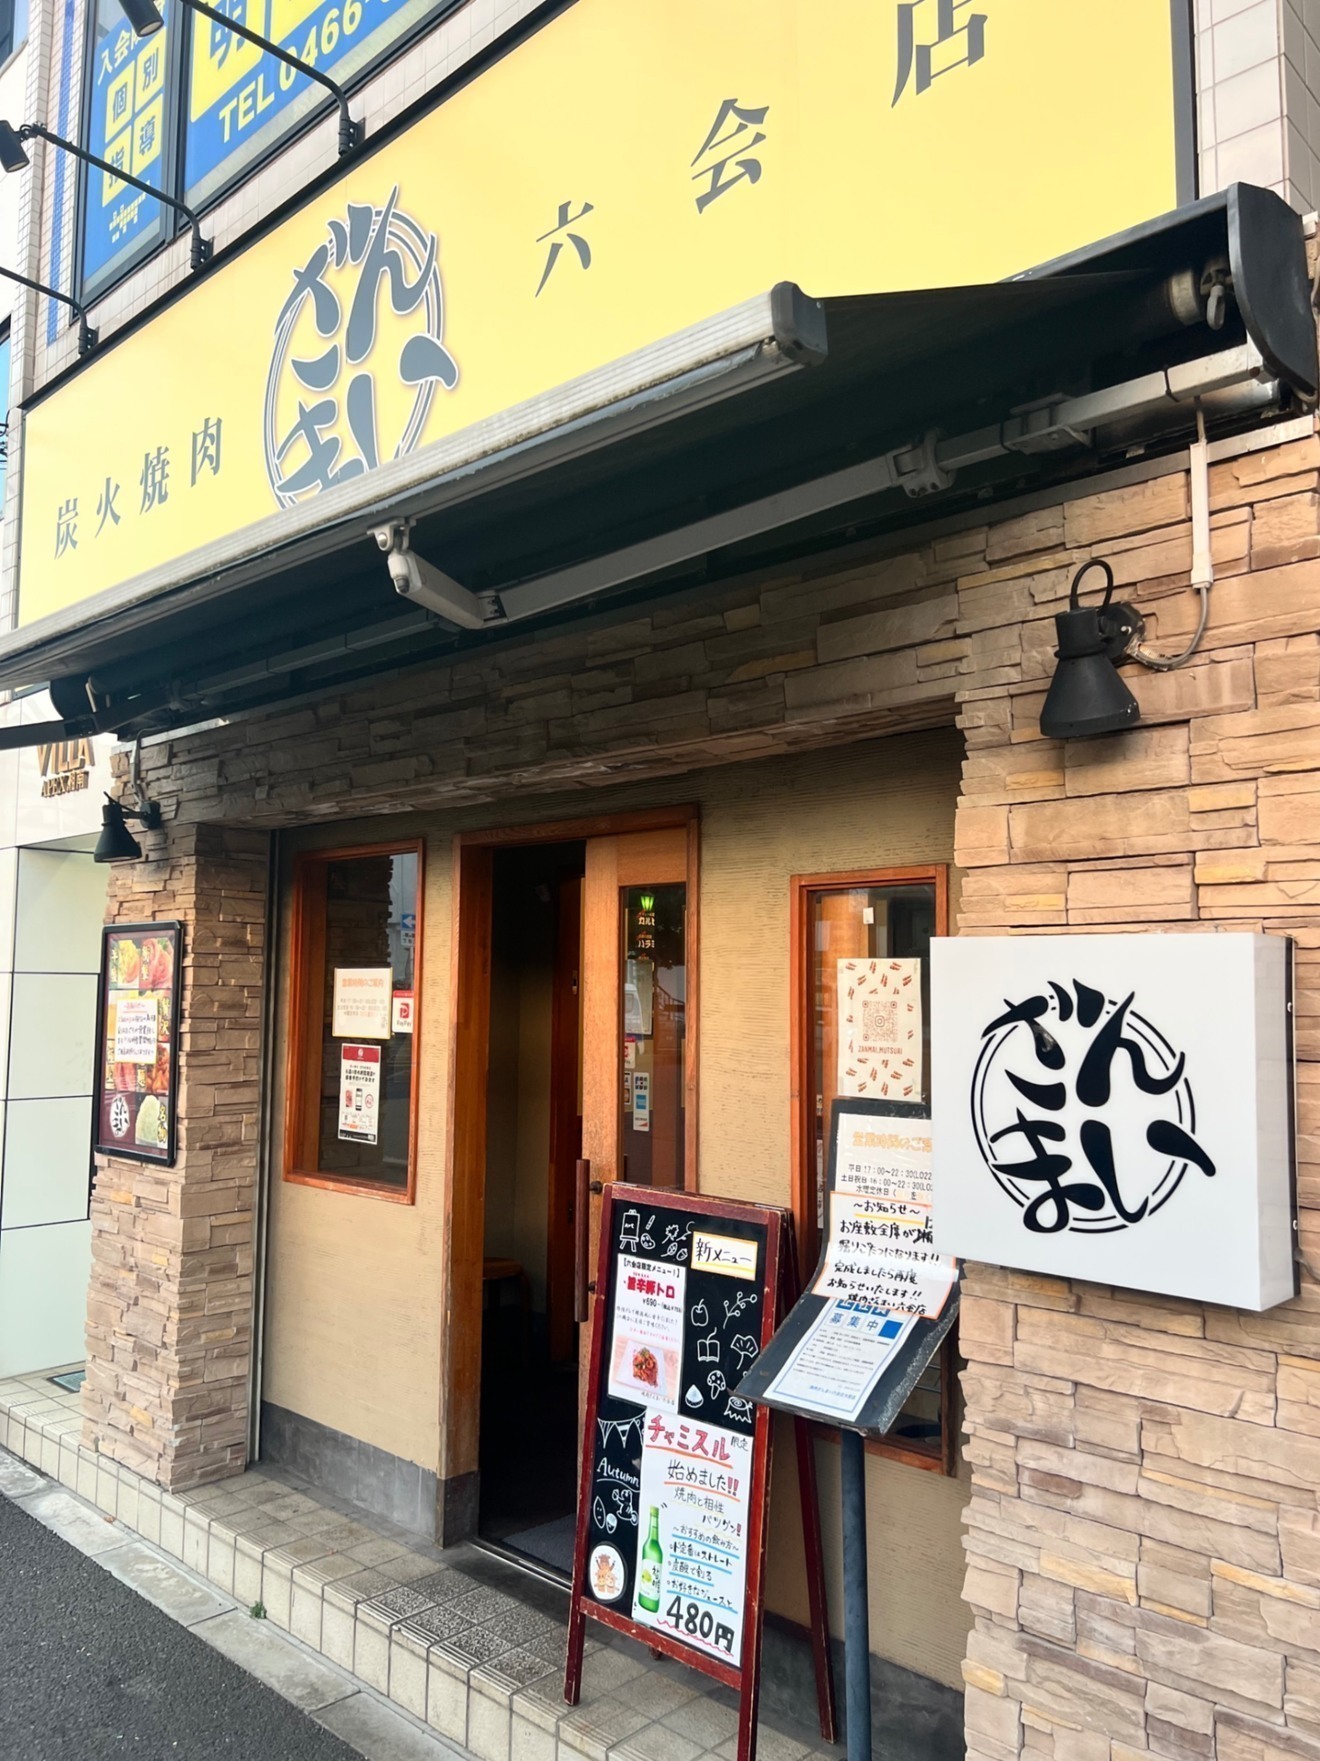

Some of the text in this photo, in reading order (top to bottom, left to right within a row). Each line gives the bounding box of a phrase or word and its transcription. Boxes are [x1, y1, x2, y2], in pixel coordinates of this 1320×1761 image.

[218, 0, 391, 144] TEL 0466
[54, 416, 223, 560] 炭火焼肉
[37, 737, 95, 778] VILLA
[980, 977, 1217, 1234] ざんまい
[841, 1174, 867, 1184] 土日祝日
[848, 1163, 862, 1173] 平日
[695, 1237, 752, 1264] 新メニュー
[829, 1312, 879, 1332] 募集中
[648, 1414, 731, 1461] チャミスル
[596, 1457, 640, 1488] Autumn
[674, 1487, 725, 1515] 焼肉と相性
[666, 1595, 735, 1653] 480円
